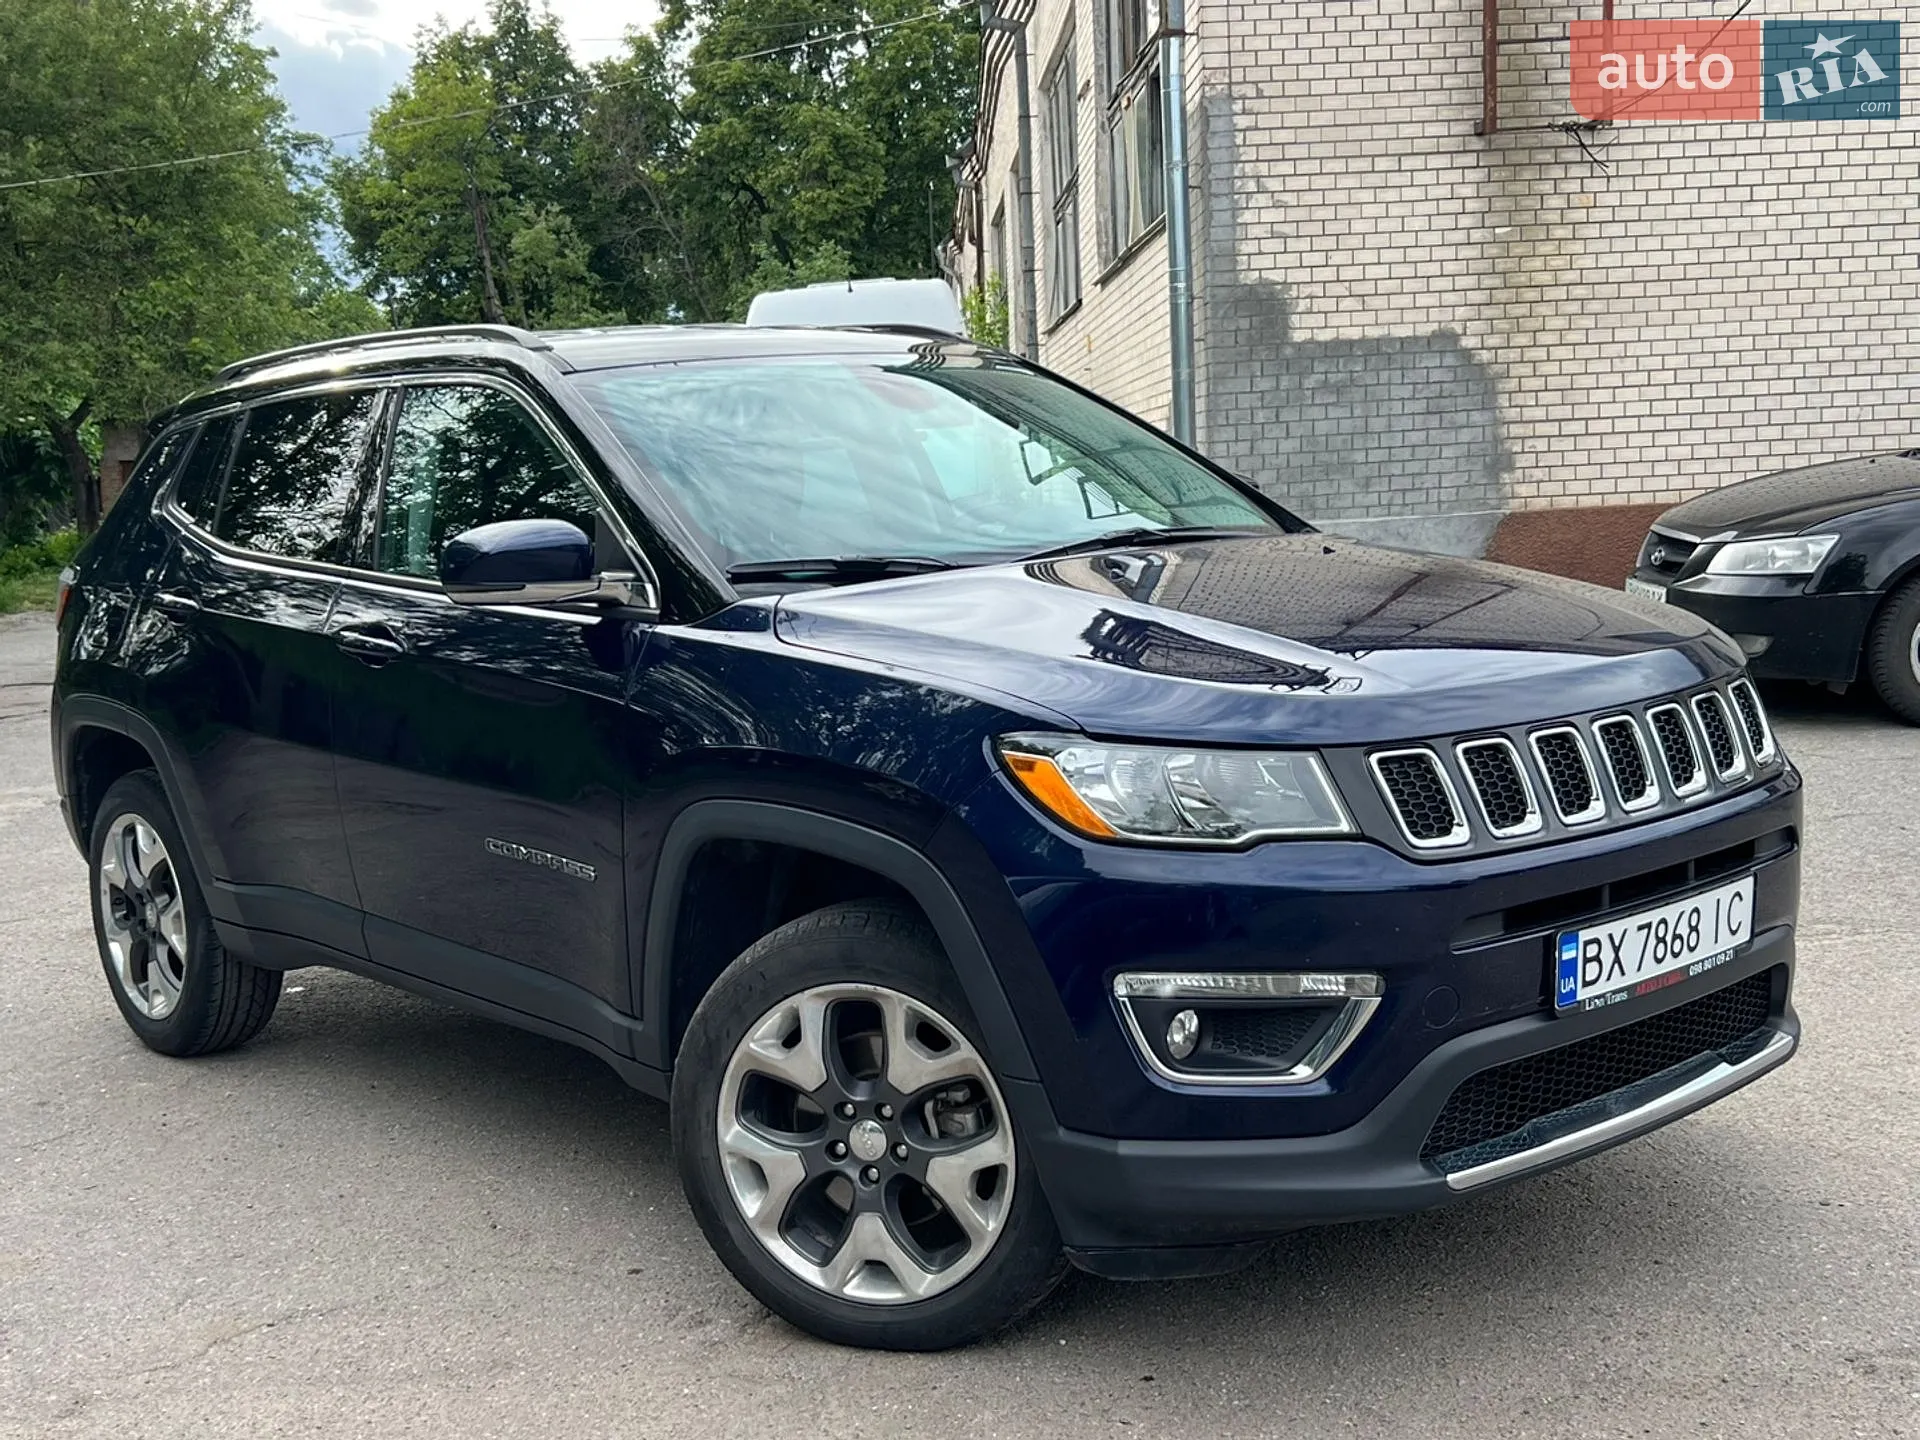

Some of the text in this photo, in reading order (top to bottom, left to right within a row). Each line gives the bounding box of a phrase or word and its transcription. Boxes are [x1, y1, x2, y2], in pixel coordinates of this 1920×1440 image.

[484, 837, 598, 882] COMPASS
[1581, 928, 1628, 989] BX
[1636, 906, 1701, 973] 7868
[1561, 975, 1576, 994] UA
